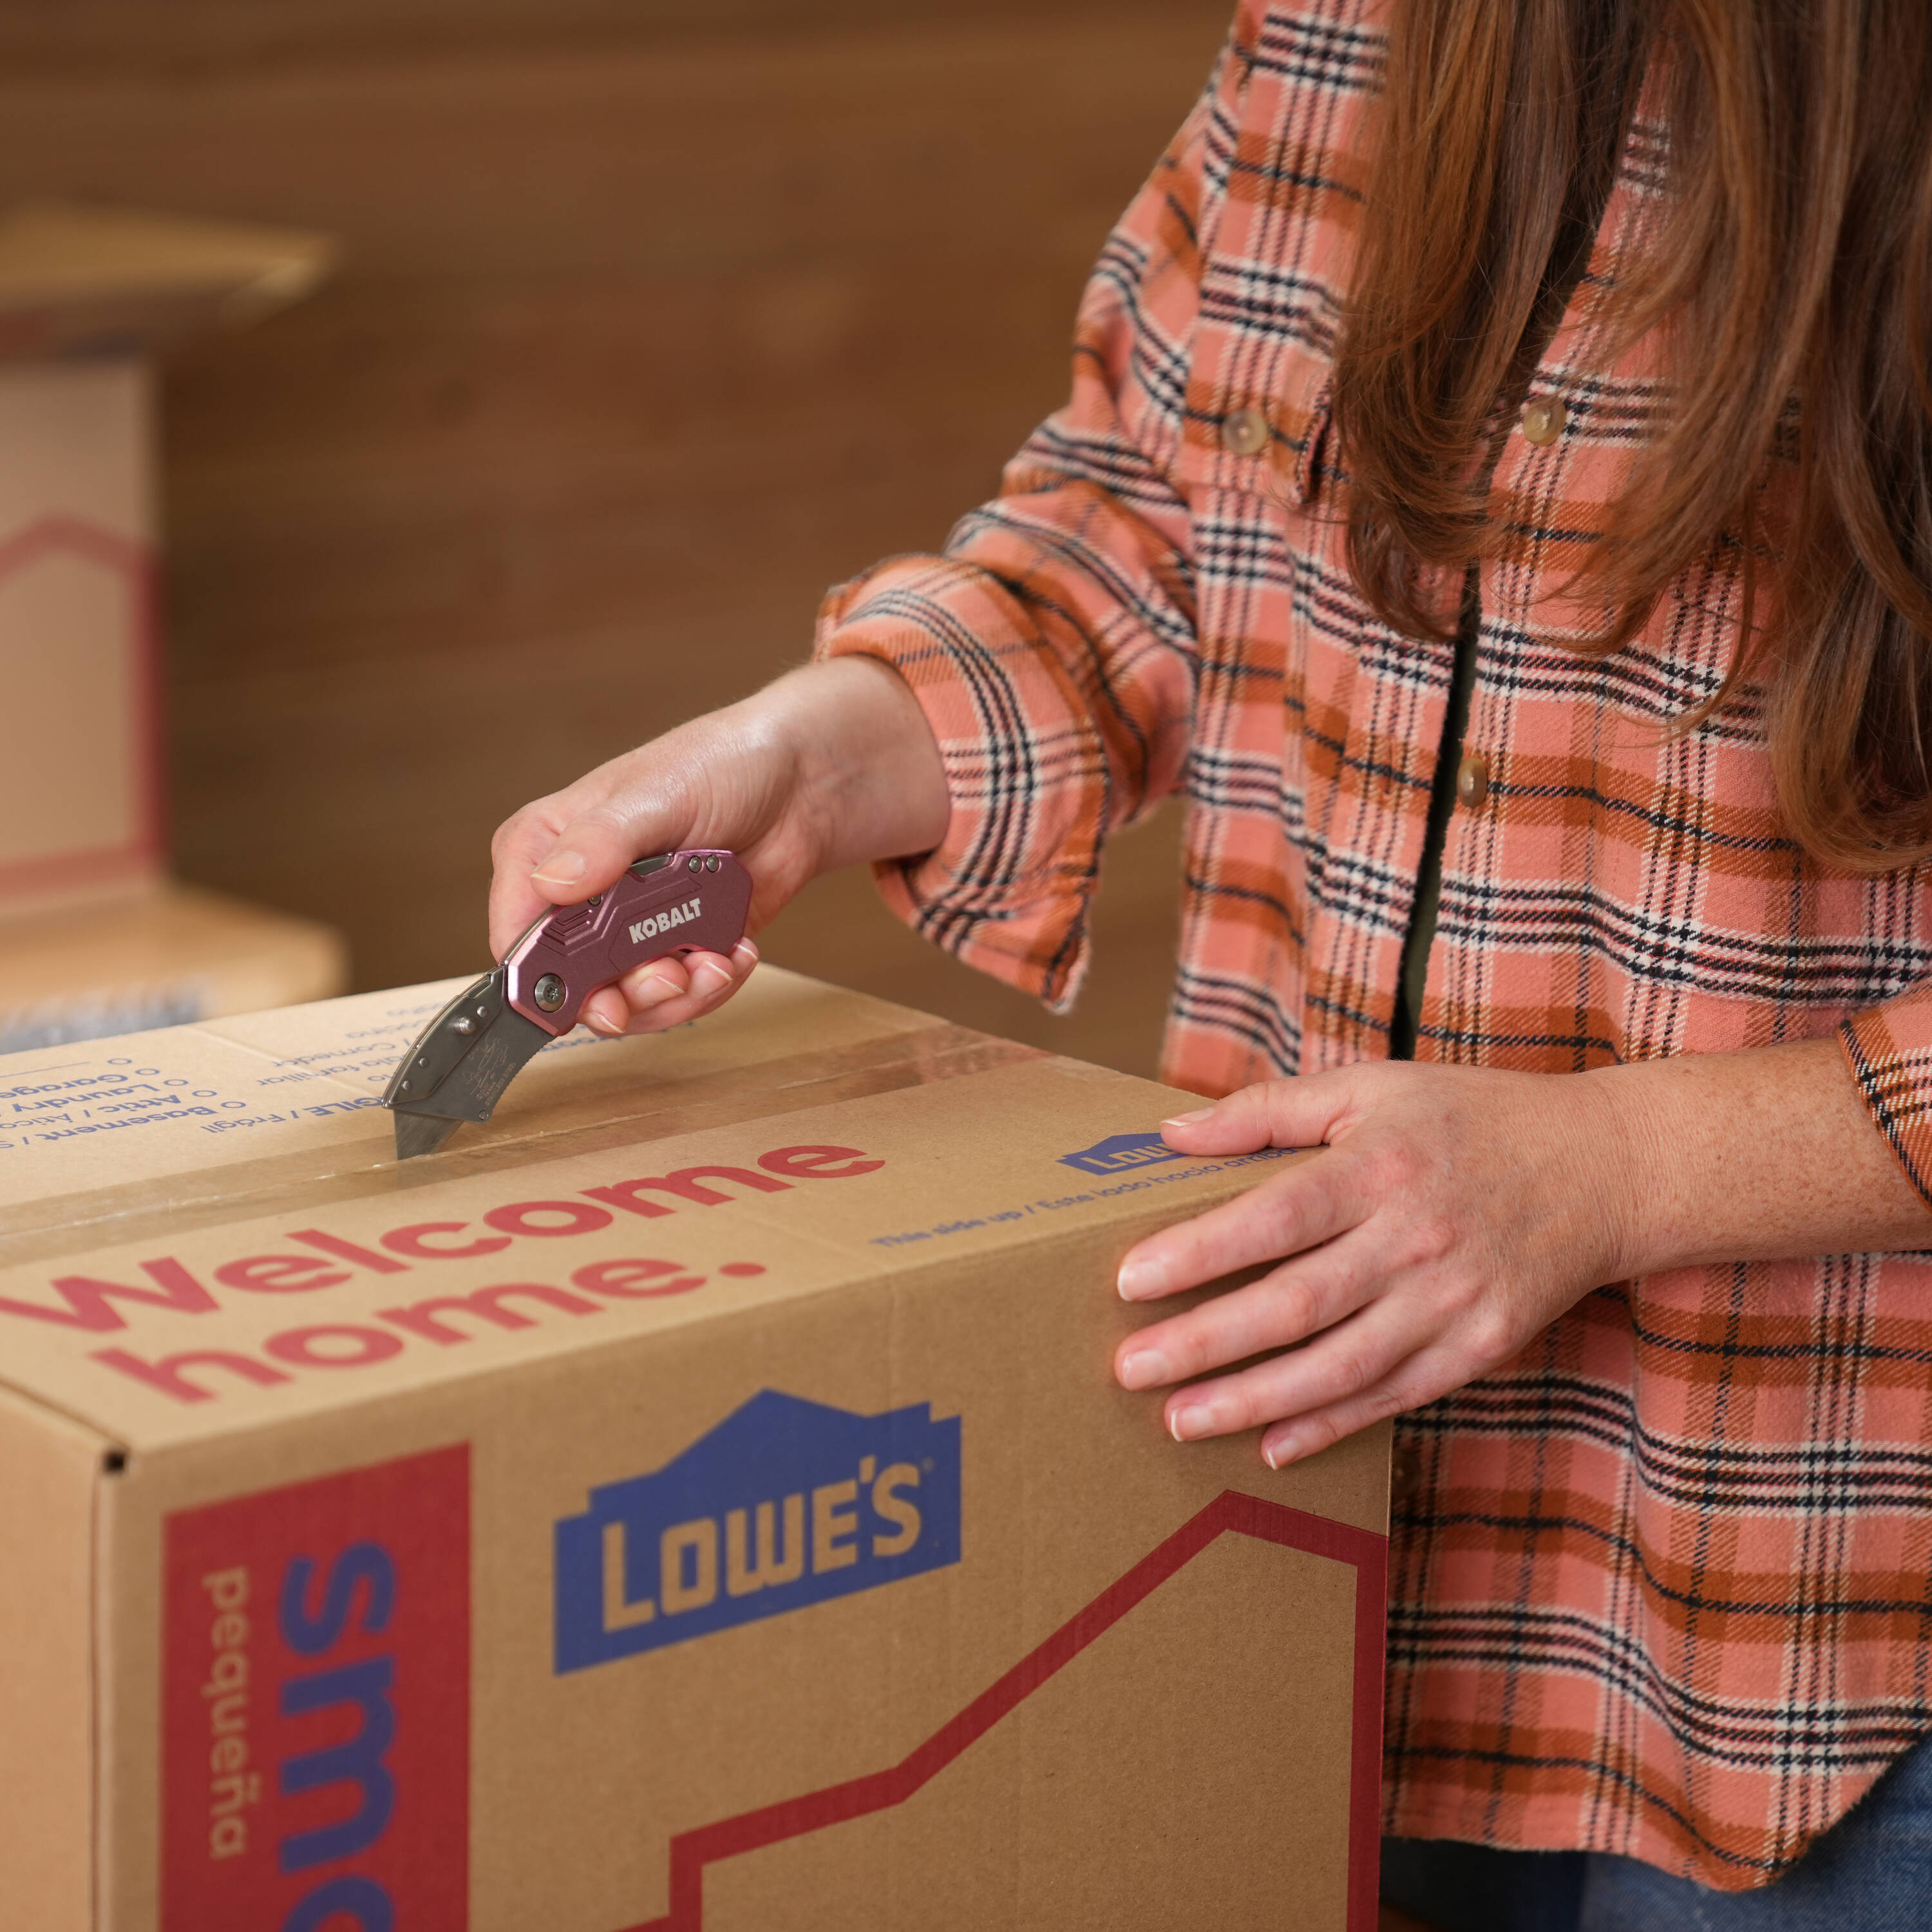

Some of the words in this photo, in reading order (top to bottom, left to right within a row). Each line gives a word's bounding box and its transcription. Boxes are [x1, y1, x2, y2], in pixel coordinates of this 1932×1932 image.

[629, 898, 701, 944] KOBALT
[256, 1065, 361, 1086] familiar
[12, 1084, 160, 1112] Laundry
[97, 1095, 181, 1112] Attic
[290, 1110, 299, 1119] /
[303, 1096, 384, 1117] GILE
[35, 1104, 216, 1141] Basement
[200, 1113, 287, 1133] Frágil
[1036, 1194, 1095, 1209] Este
[1090, 1181, 1151, 1198] lado
[1150, 1164, 1224, 1183] hacia
[1225, 1148, 1301, 1168] arriba
[0, 1145, 886, 1333] Welcome
[86, 1258, 766, 1406] home.
[602, 1454, 922, 1633] LOWE'S
[201, 1564, 261, 1861] pequeña
